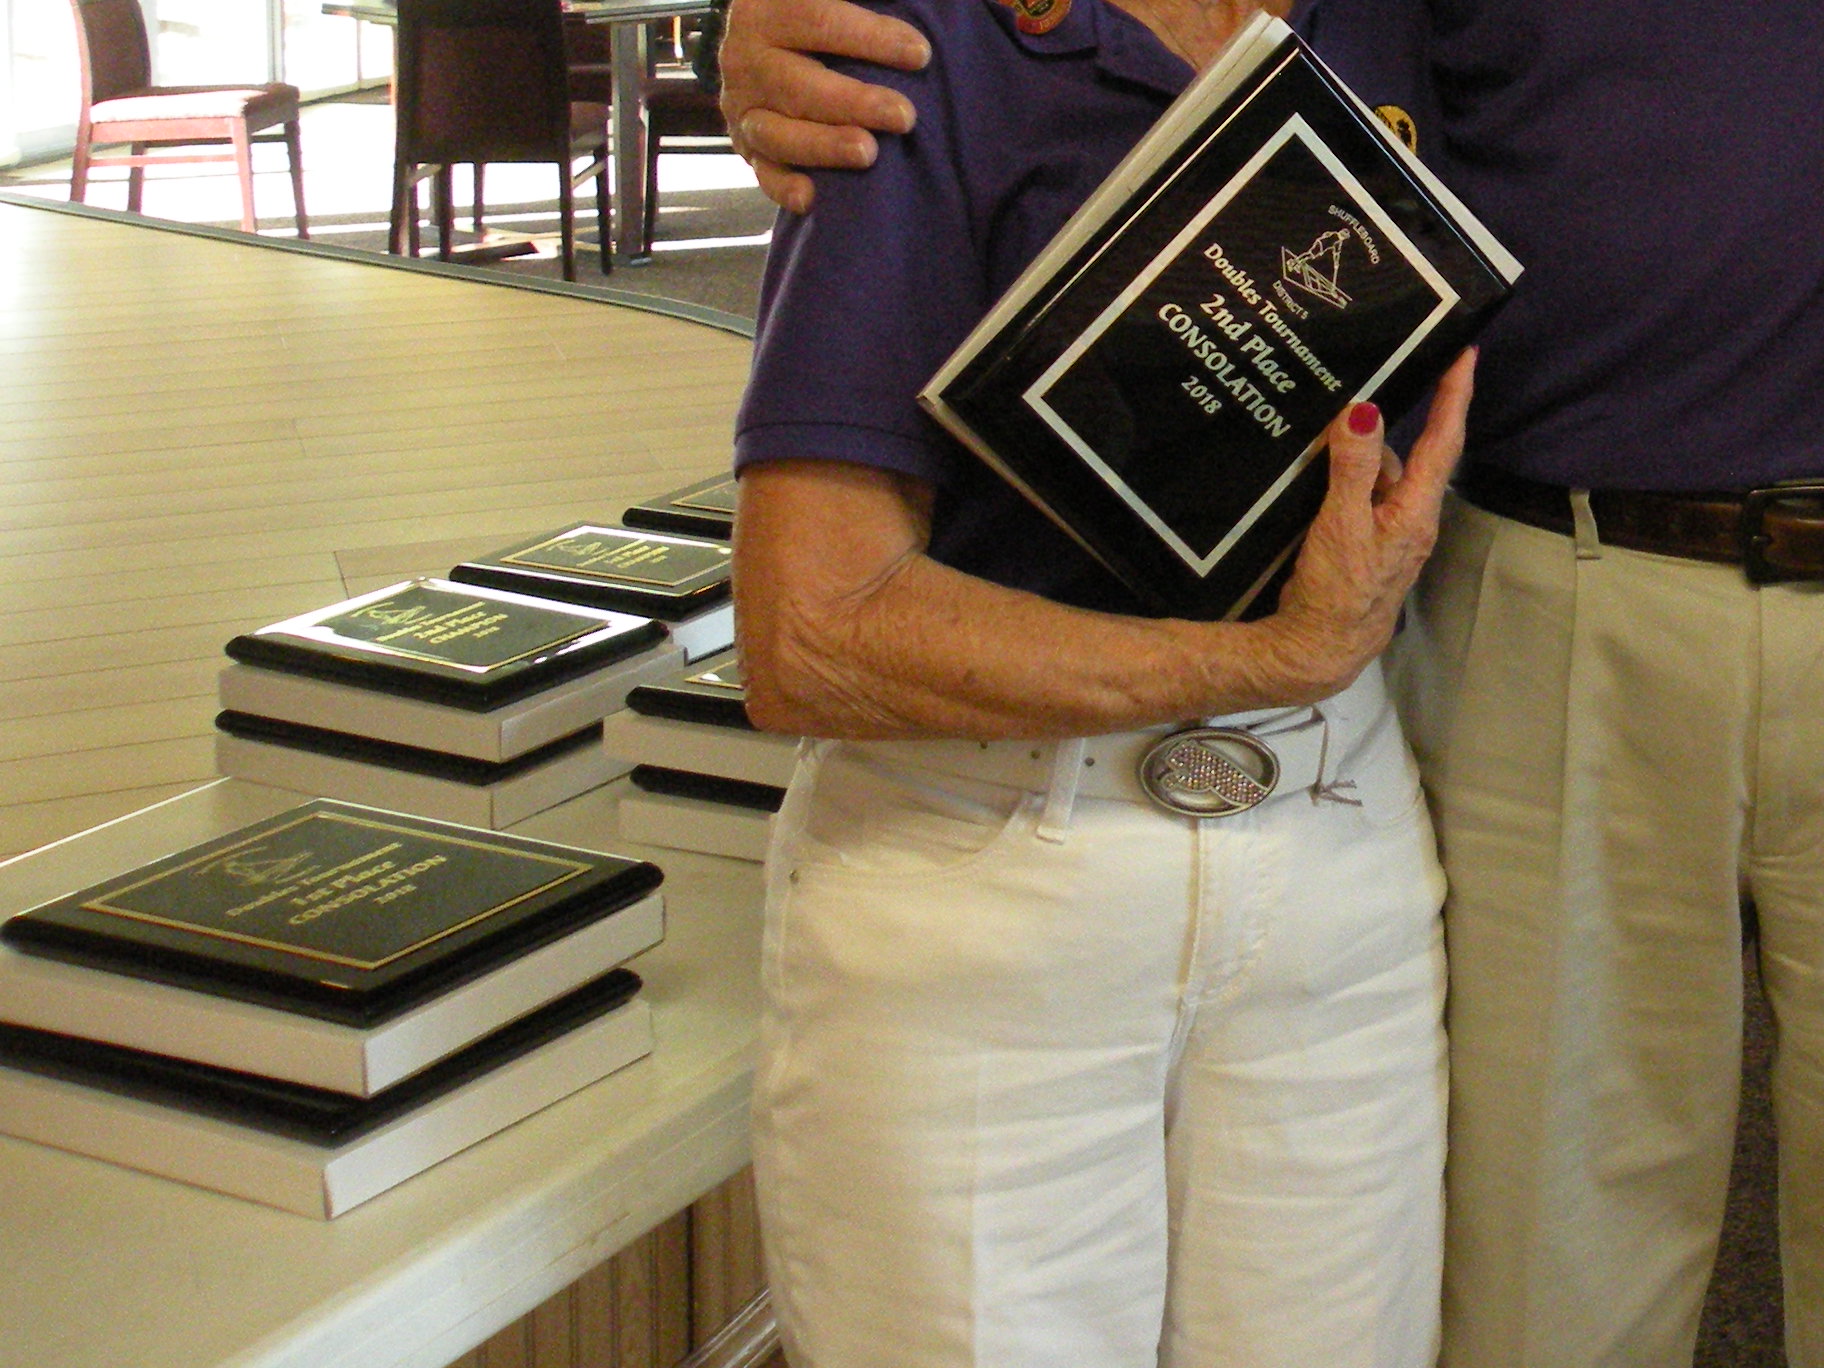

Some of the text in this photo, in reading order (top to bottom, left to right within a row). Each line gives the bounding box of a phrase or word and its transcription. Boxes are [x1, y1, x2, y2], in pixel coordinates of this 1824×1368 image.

[1327, 203, 1381, 266] SHUFFLEBOARD
[1203, 242, 1343, 393] Doubles Tournament
[1272, 279, 1302, 317] DISTRICT
[1158, 303, 1292, 439] CONSOLATION
[1200, 293, 1297, 394] 2nd Place
[1181, 375, 1223, 415] 2018
[288, 854, 448, 926] CONSOLATION
[330, 860, 397, 890] Place
